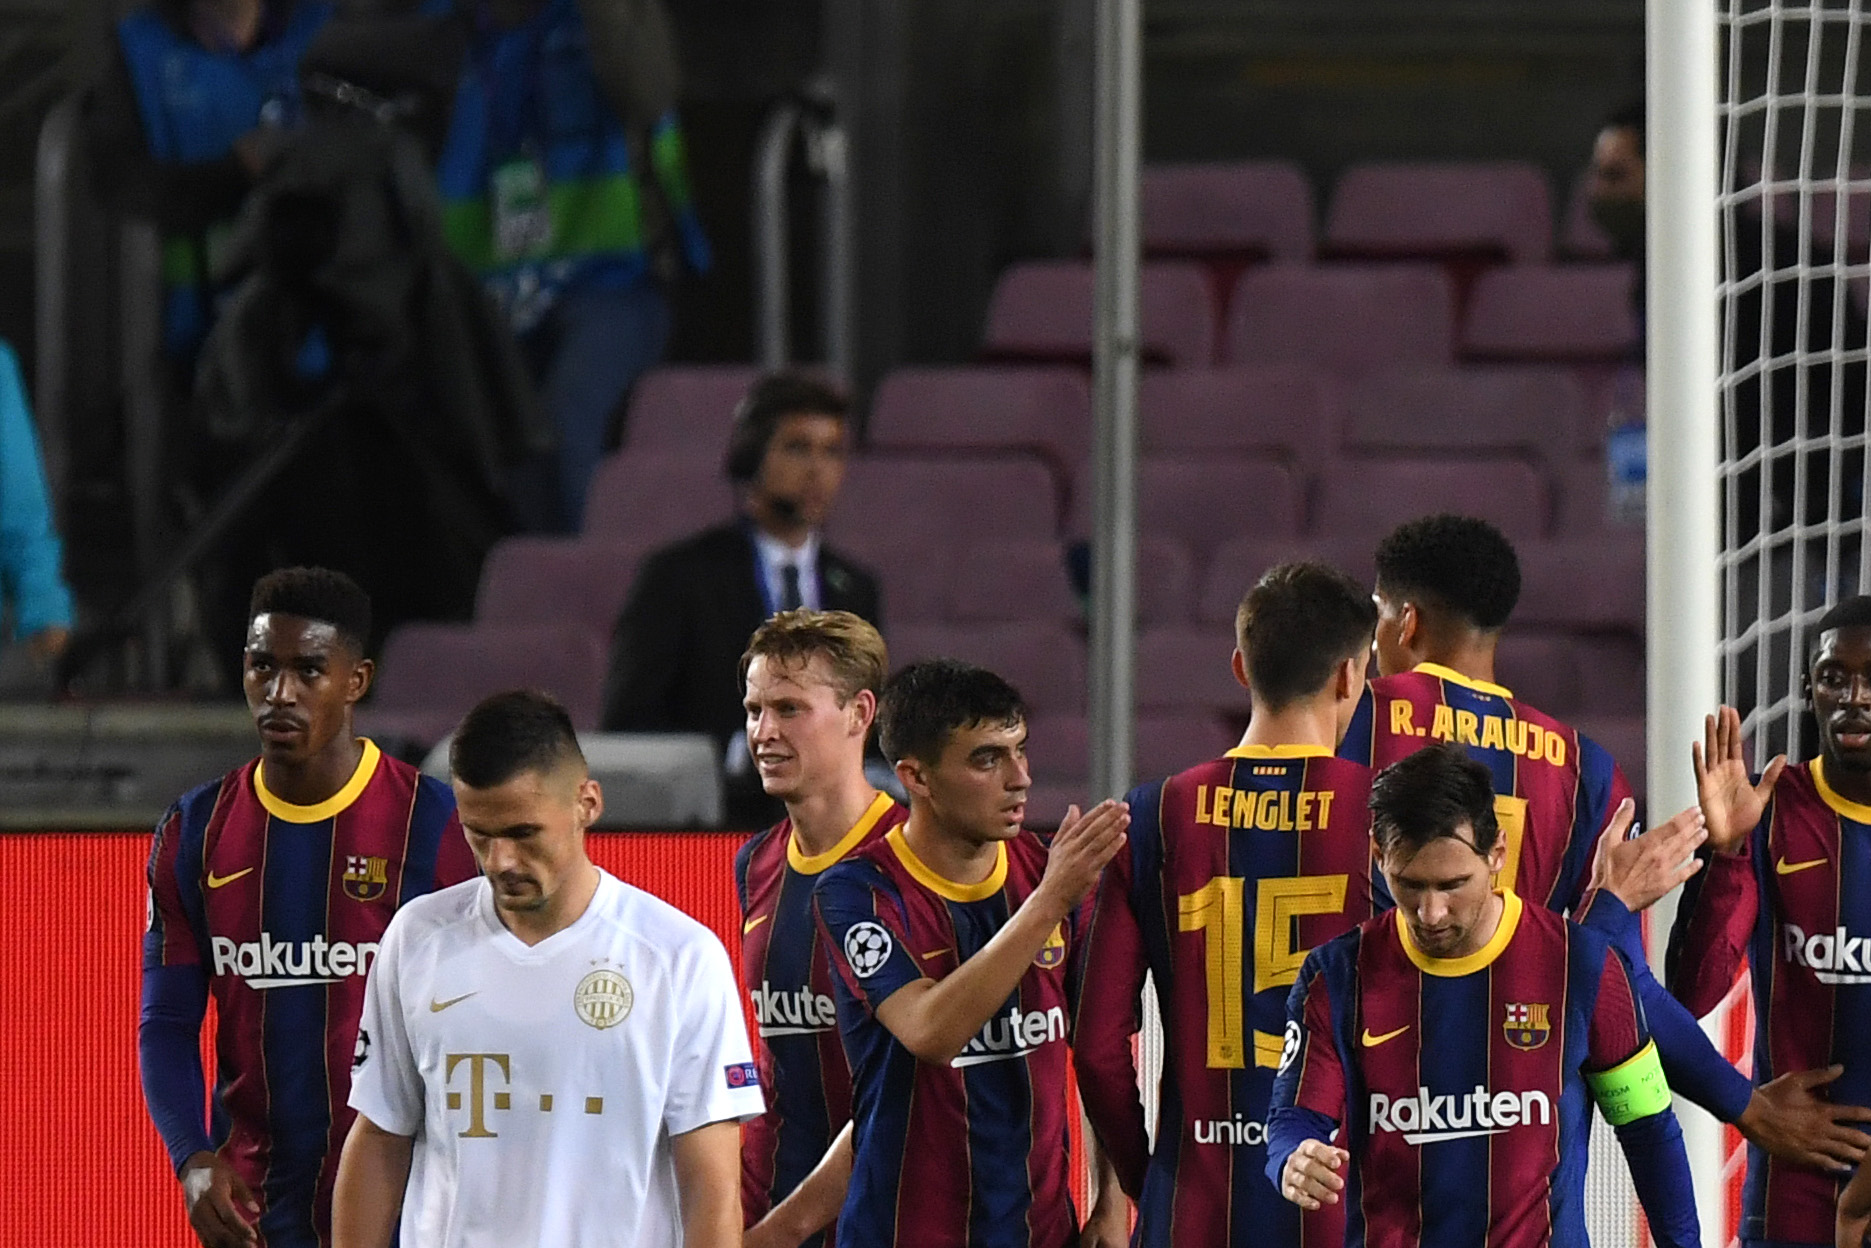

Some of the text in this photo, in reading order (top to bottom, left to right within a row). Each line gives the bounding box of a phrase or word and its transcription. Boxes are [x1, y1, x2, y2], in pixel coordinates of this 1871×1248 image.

[1390, 699, 1566, 767] R. ARAUJO
[1195, 784, 1335, 832] LENGLET
[1177, 873, 1349, 1070] 15
[750, 980, 836, 1026] akute
[1194, 1112, 1269, 1146] unic
[1369, 1085, 1550, 1135] Rakuten
